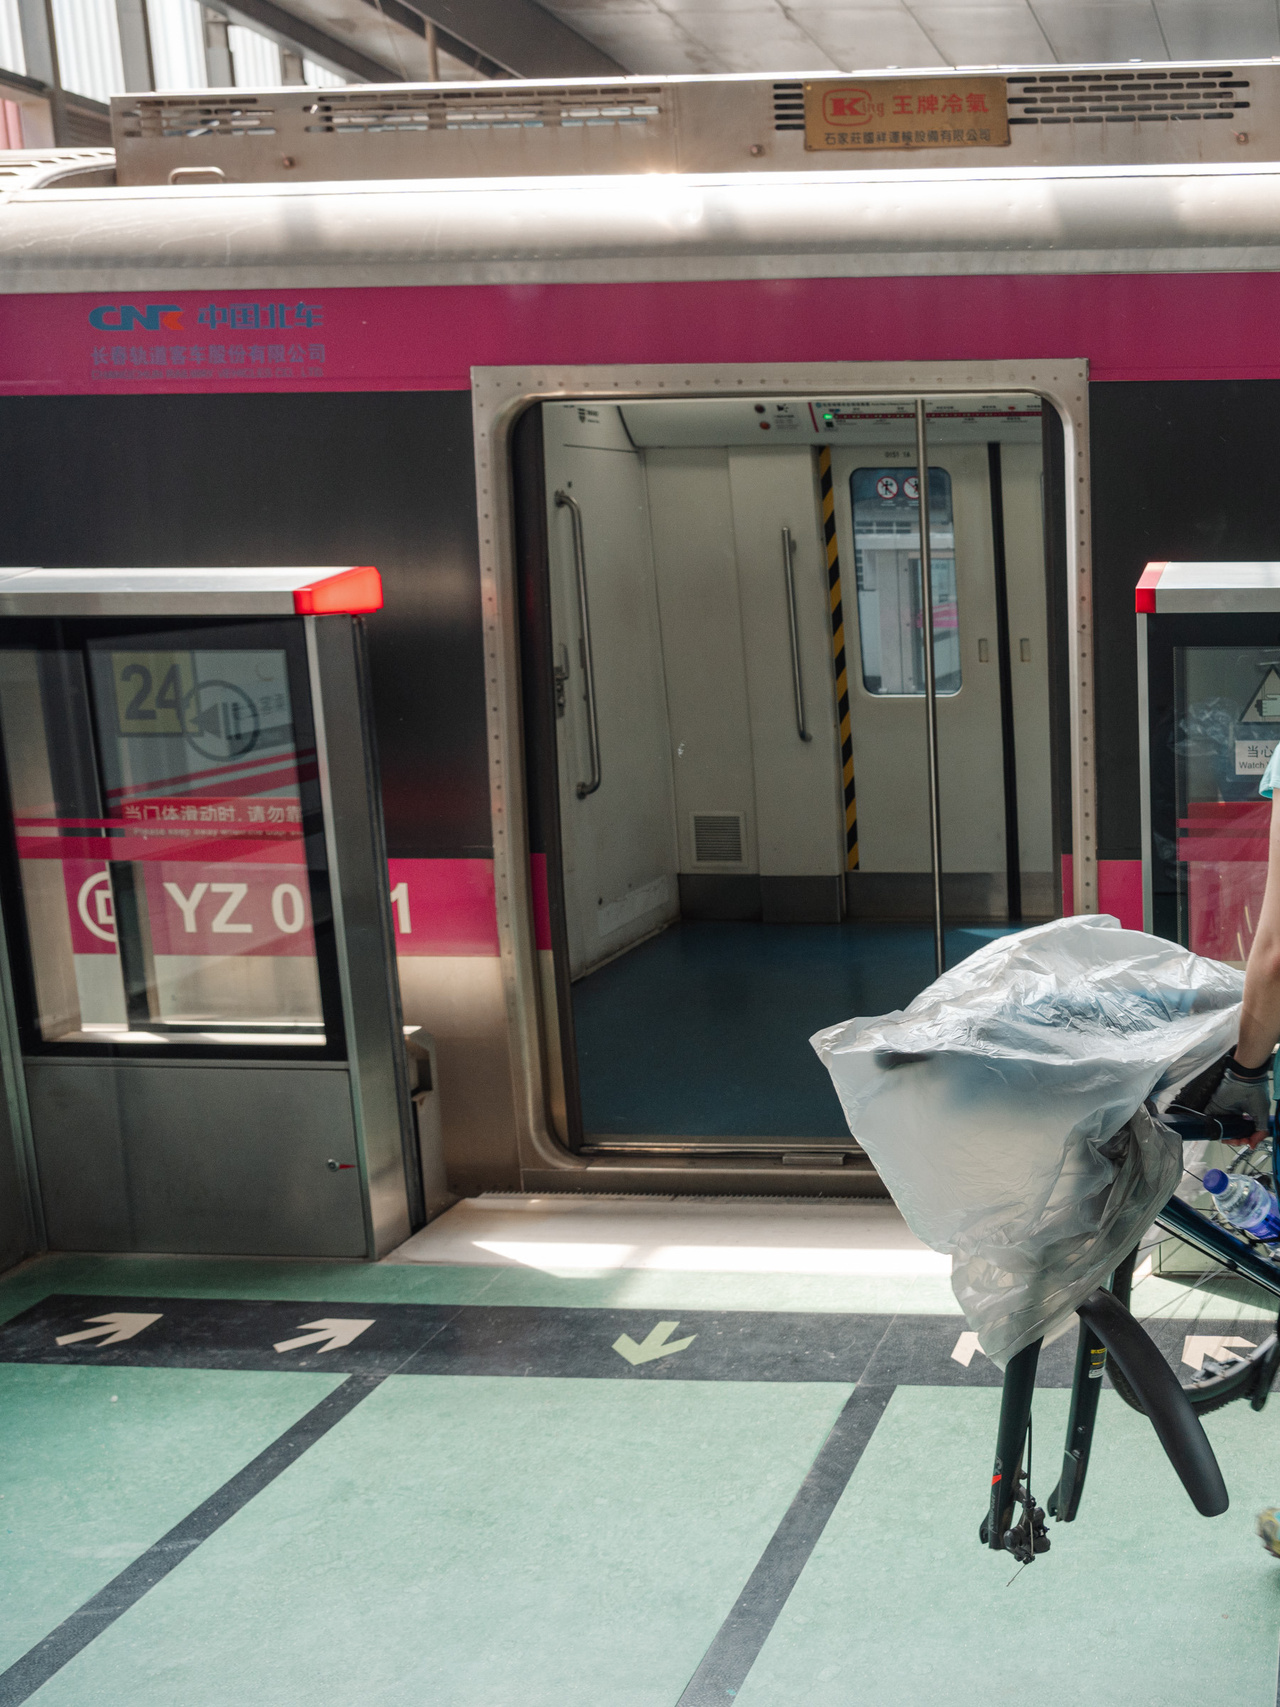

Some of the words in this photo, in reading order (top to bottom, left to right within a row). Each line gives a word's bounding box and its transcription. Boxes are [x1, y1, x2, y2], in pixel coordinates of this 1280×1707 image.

[892, 92, 989, 115] 王牌冷氣
[197, 302, 325, 330] 中国北车
[90, 343, 327, 366] 长春轨道客车股份有限公司
[120, 664, 185, 721] 24
[1238, 761, 1265, 769] Watch
[164, 882, 254, 934] YZ
